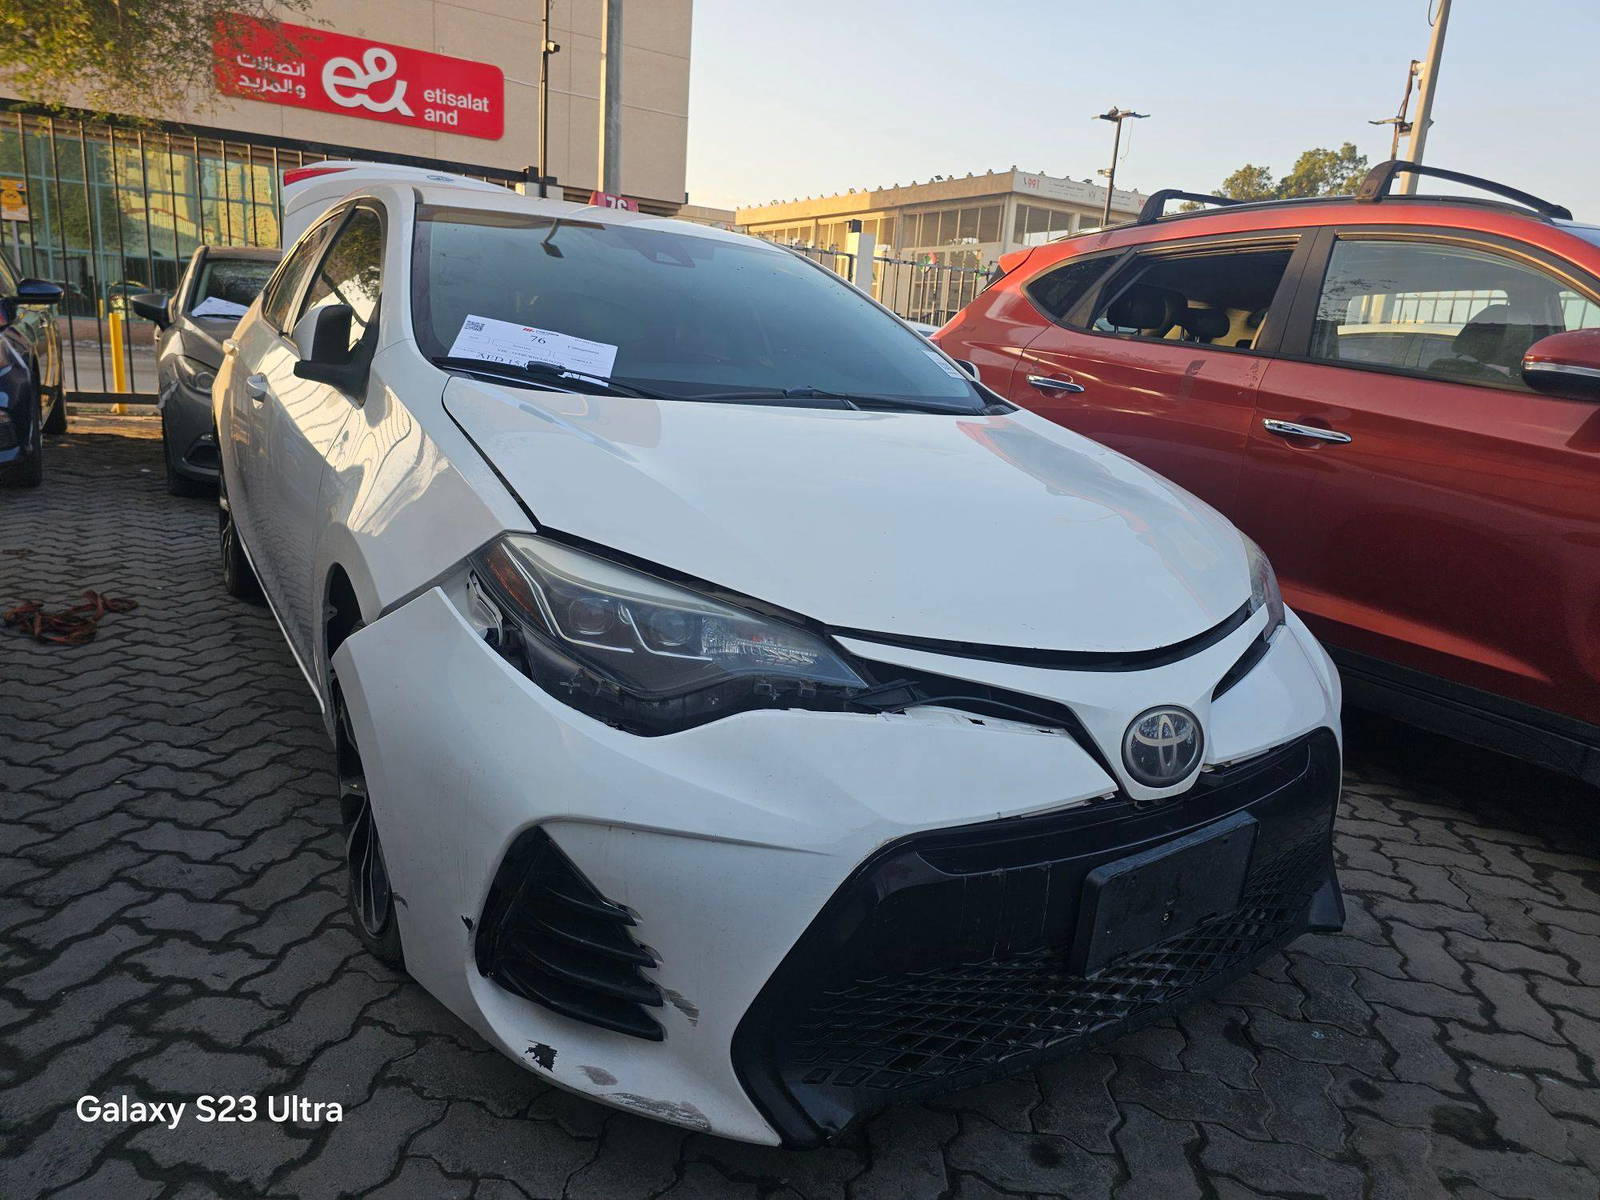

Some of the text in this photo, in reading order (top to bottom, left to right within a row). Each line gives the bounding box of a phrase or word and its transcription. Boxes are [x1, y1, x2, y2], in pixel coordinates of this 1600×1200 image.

[423, 88, 489, 113] etisalat
[424, 108, 459, 126] and
[530, 335, 546, 345] 76
